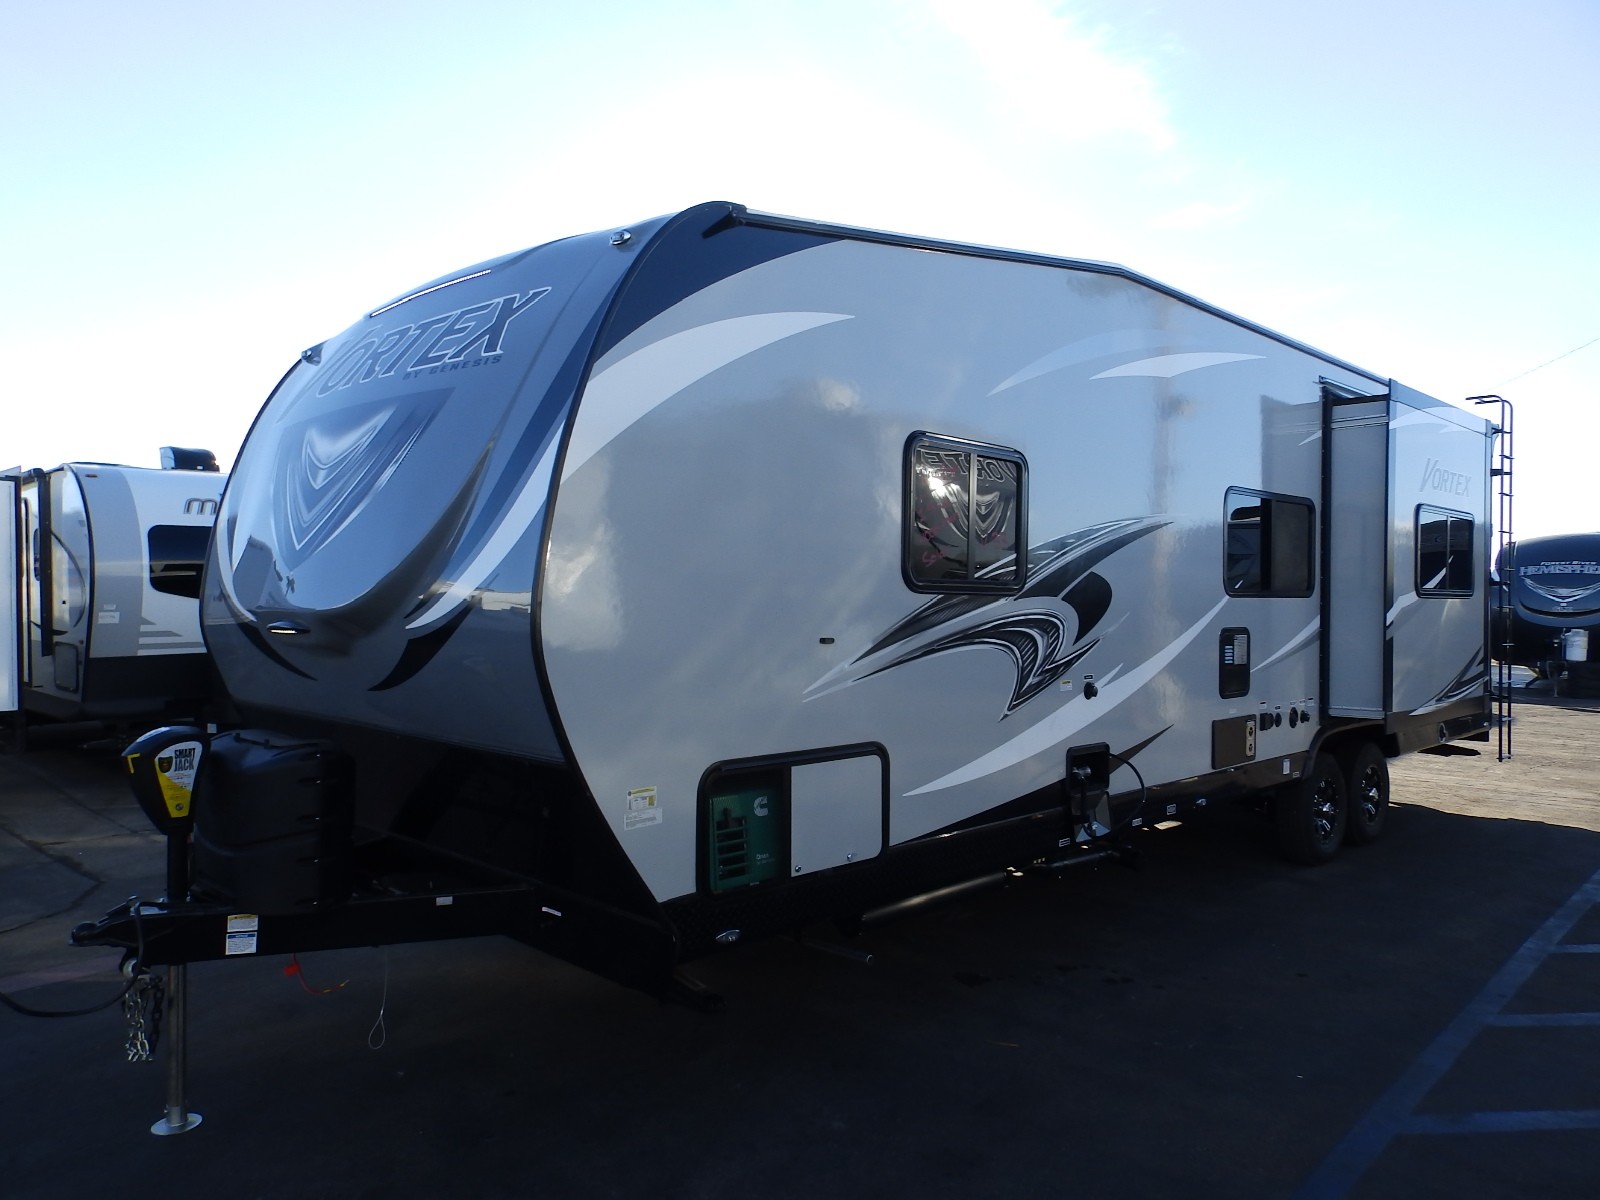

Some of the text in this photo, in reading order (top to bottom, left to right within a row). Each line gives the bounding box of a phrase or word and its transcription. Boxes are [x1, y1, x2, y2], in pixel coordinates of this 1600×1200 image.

[428, 356, 502, 375] GENESIS
[1418, 457, 1472, 498] VORTEX
[174, 748, 196, 759] SMART
[174, 758, 195, 772] JACK
